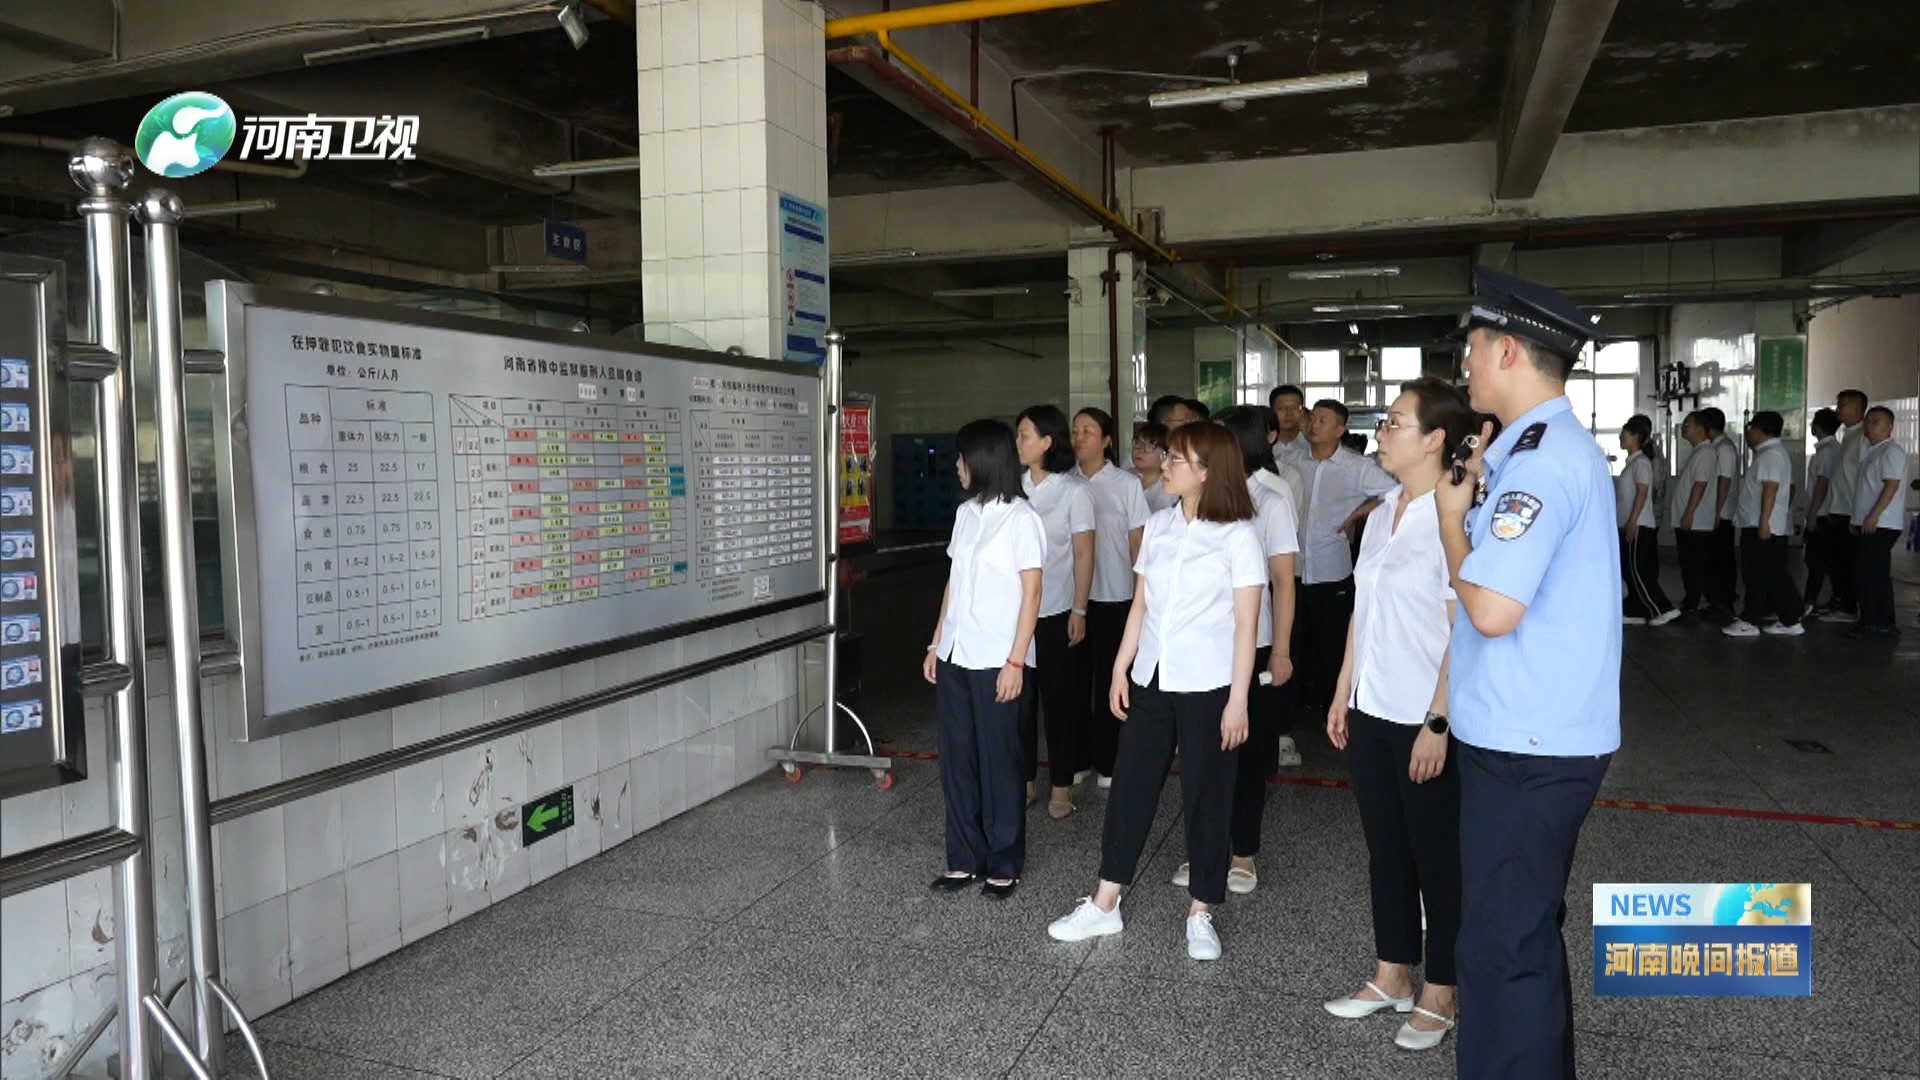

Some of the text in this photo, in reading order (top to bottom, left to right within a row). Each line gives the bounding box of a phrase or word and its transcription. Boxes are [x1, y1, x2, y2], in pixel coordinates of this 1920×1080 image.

[366, 400, 387, 412] 标准
[299, 413, 321, 425] 品种
[338, 430, 365, 442] 重体力
[374, 430, 400, 443] 轻体力
[348, 463, 359, 472] 25
[380, 462, 398, 472] 22.5
[417, 462, 425, 472] 17
[382, 493, 399, 503] 22.5
[414, 491, 431, 501] 22.5
[347, 525, 366, 536] 0.75
[383, 522, 401, 533] 0.75
[416, 520, 432, 531] 0.75
